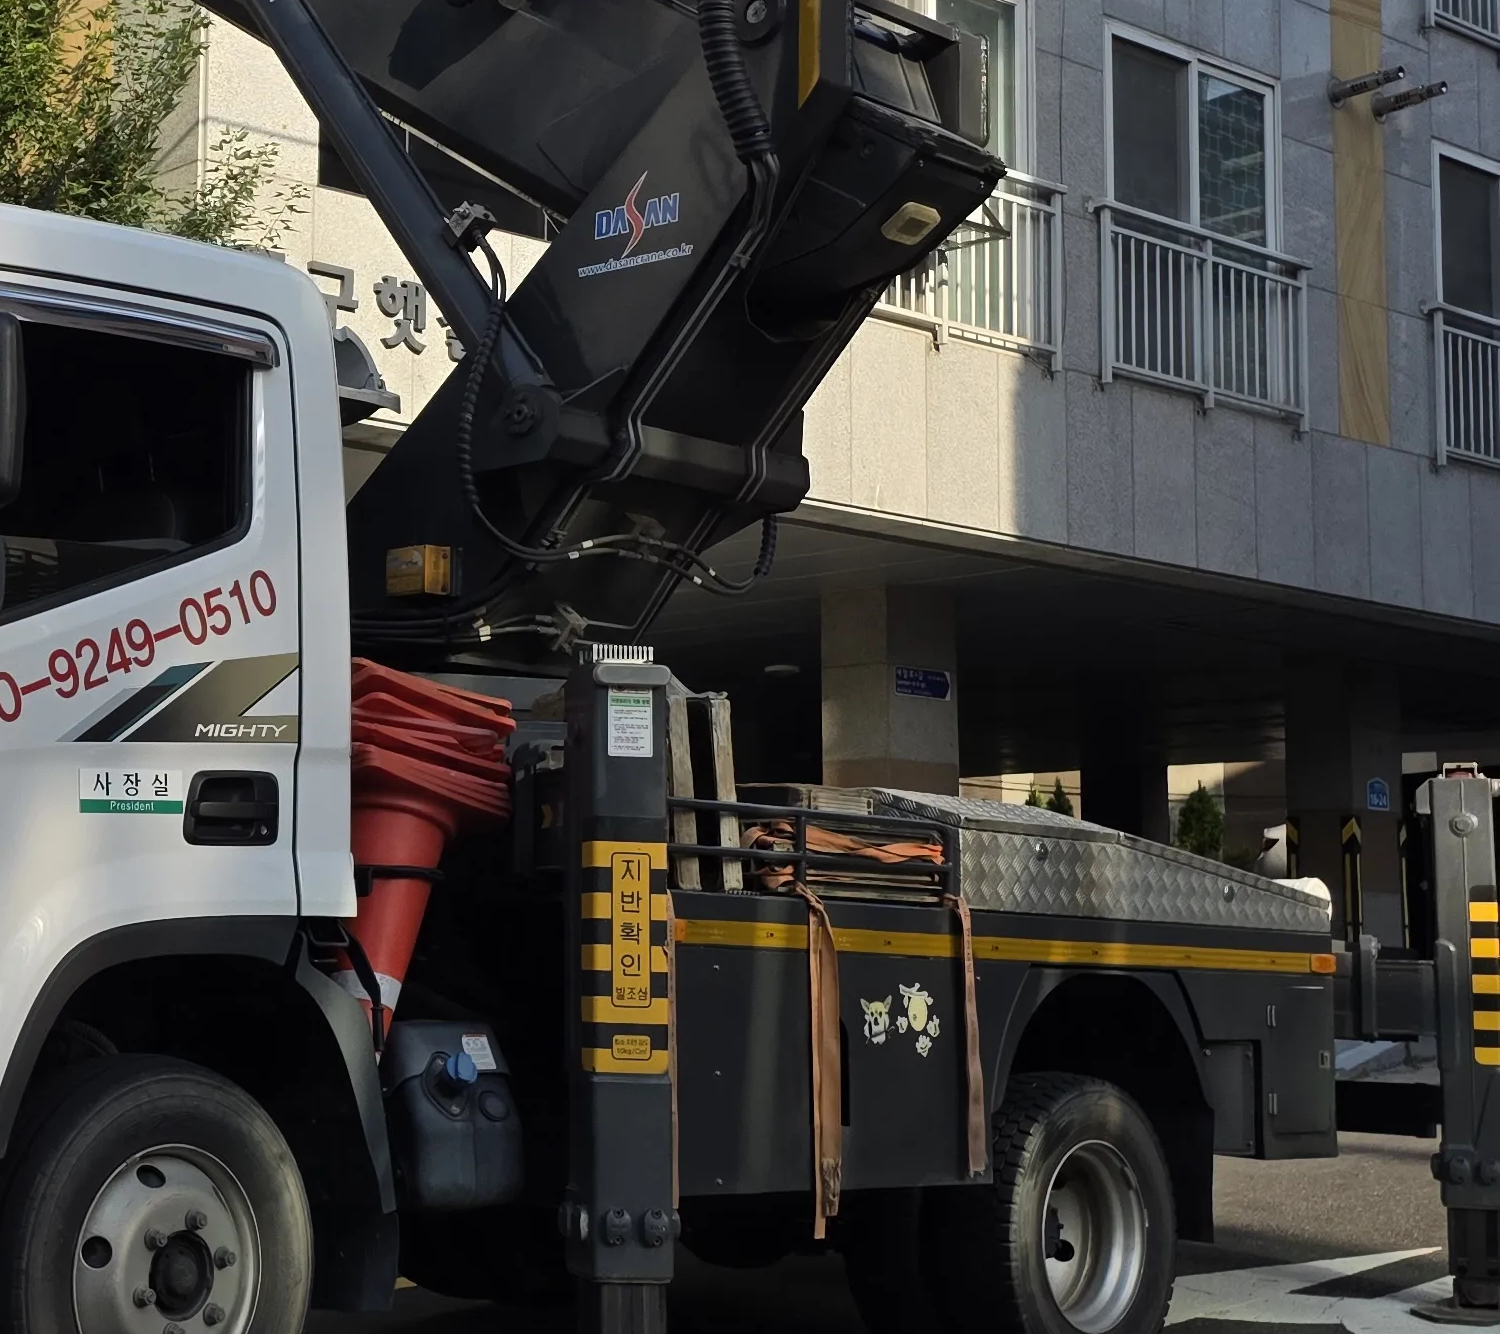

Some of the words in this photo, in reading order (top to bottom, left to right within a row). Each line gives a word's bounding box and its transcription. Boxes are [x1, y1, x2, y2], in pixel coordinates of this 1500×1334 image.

[595, 170, 680, 259] DASAN
[578, 243, 694, 278] www.dasancrane.co.kr
[195, 724, 288, 738] MIGHTY
[110, 801, 155, 812] President
